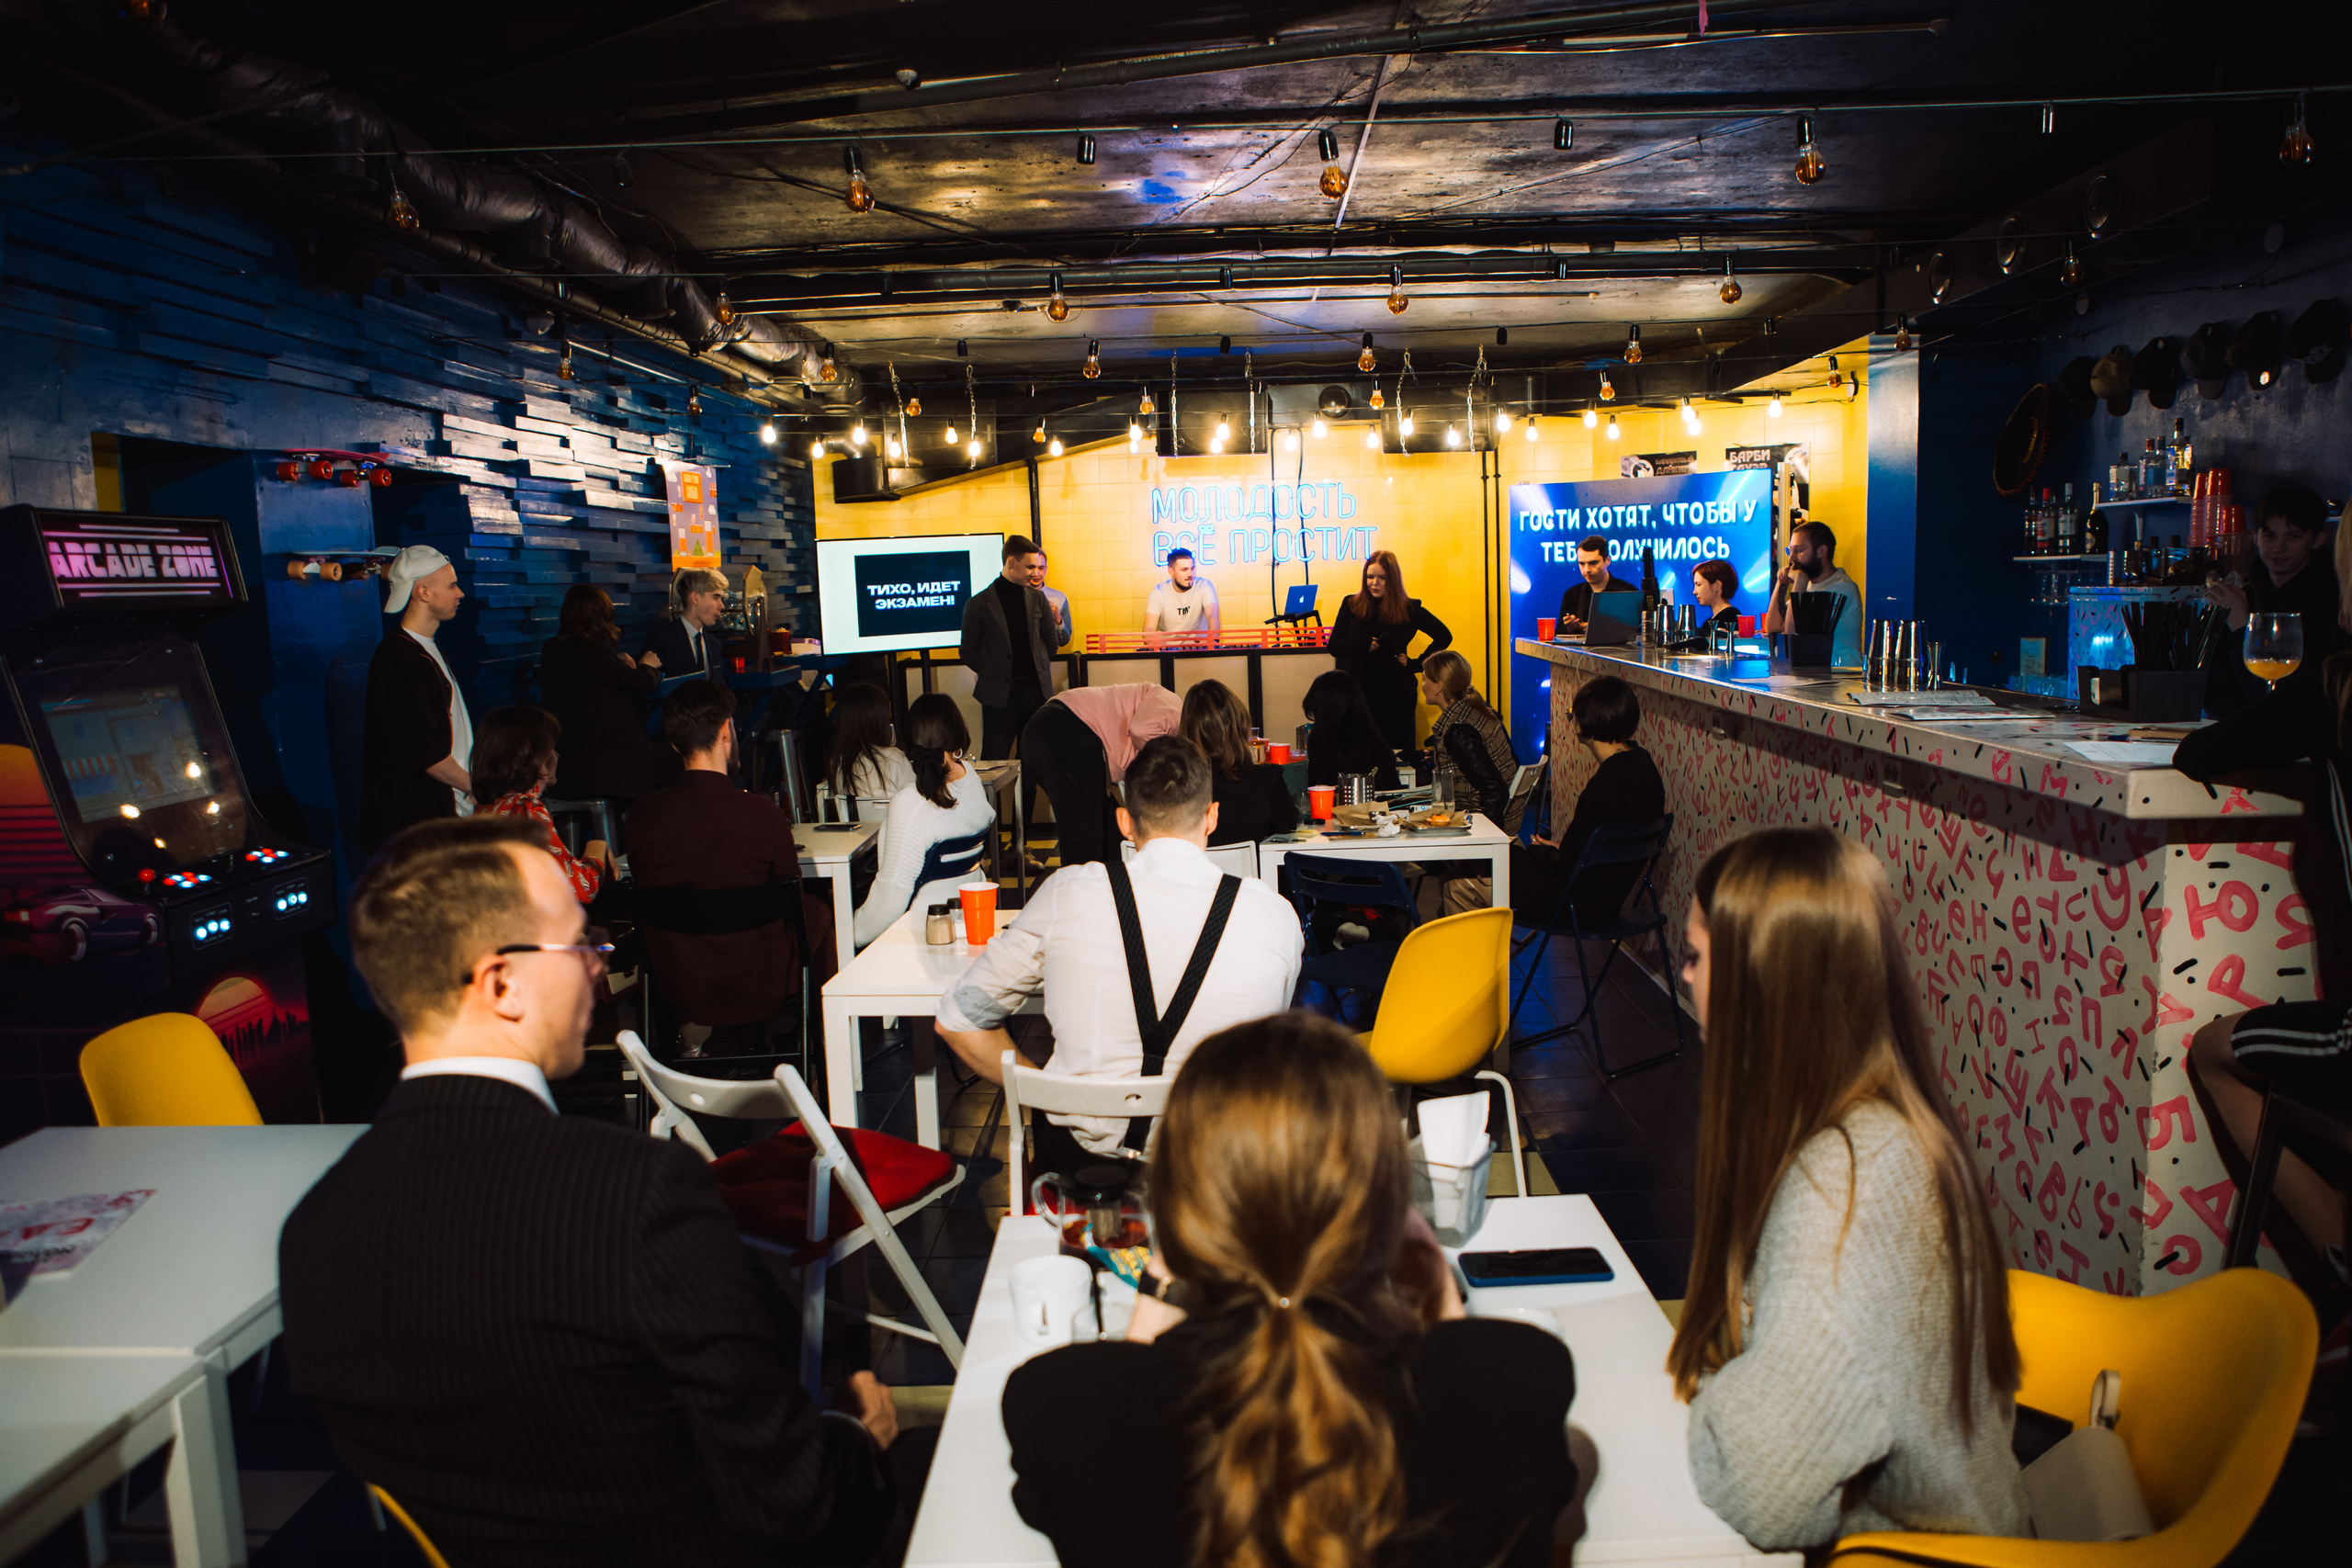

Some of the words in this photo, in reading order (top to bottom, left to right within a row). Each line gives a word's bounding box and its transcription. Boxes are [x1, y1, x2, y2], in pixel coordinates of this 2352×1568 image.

[1729, 449, 1770, 463] БАРБИ
[1151, 482, 1356, 524] МОЛОДОСТЬ
[1519, 507, 1579, 532] ГОСТИ
[1586, 503, 1657, 530] ХОТЯТ,
[1662, 500, 1736, 526] ЧТОБЫ
[1744, 499, 1757, 523] У
[48, 541, 158, 578] ARCADE
[158, 545, 219, 578] ZONE
[1229, 525, 1377, 564] ПРОСТИТ
[1541, 541, 1577, 563] ТЕБ
[1608, 536, 1730, 561] ОЛУЧИЛОСЬ
[866, 582, 916, 597] ТИХО,
[917, 581, 961, 594] ИДЕТ
[875, 594, 956, 610] ЭКЗАМЕН!
